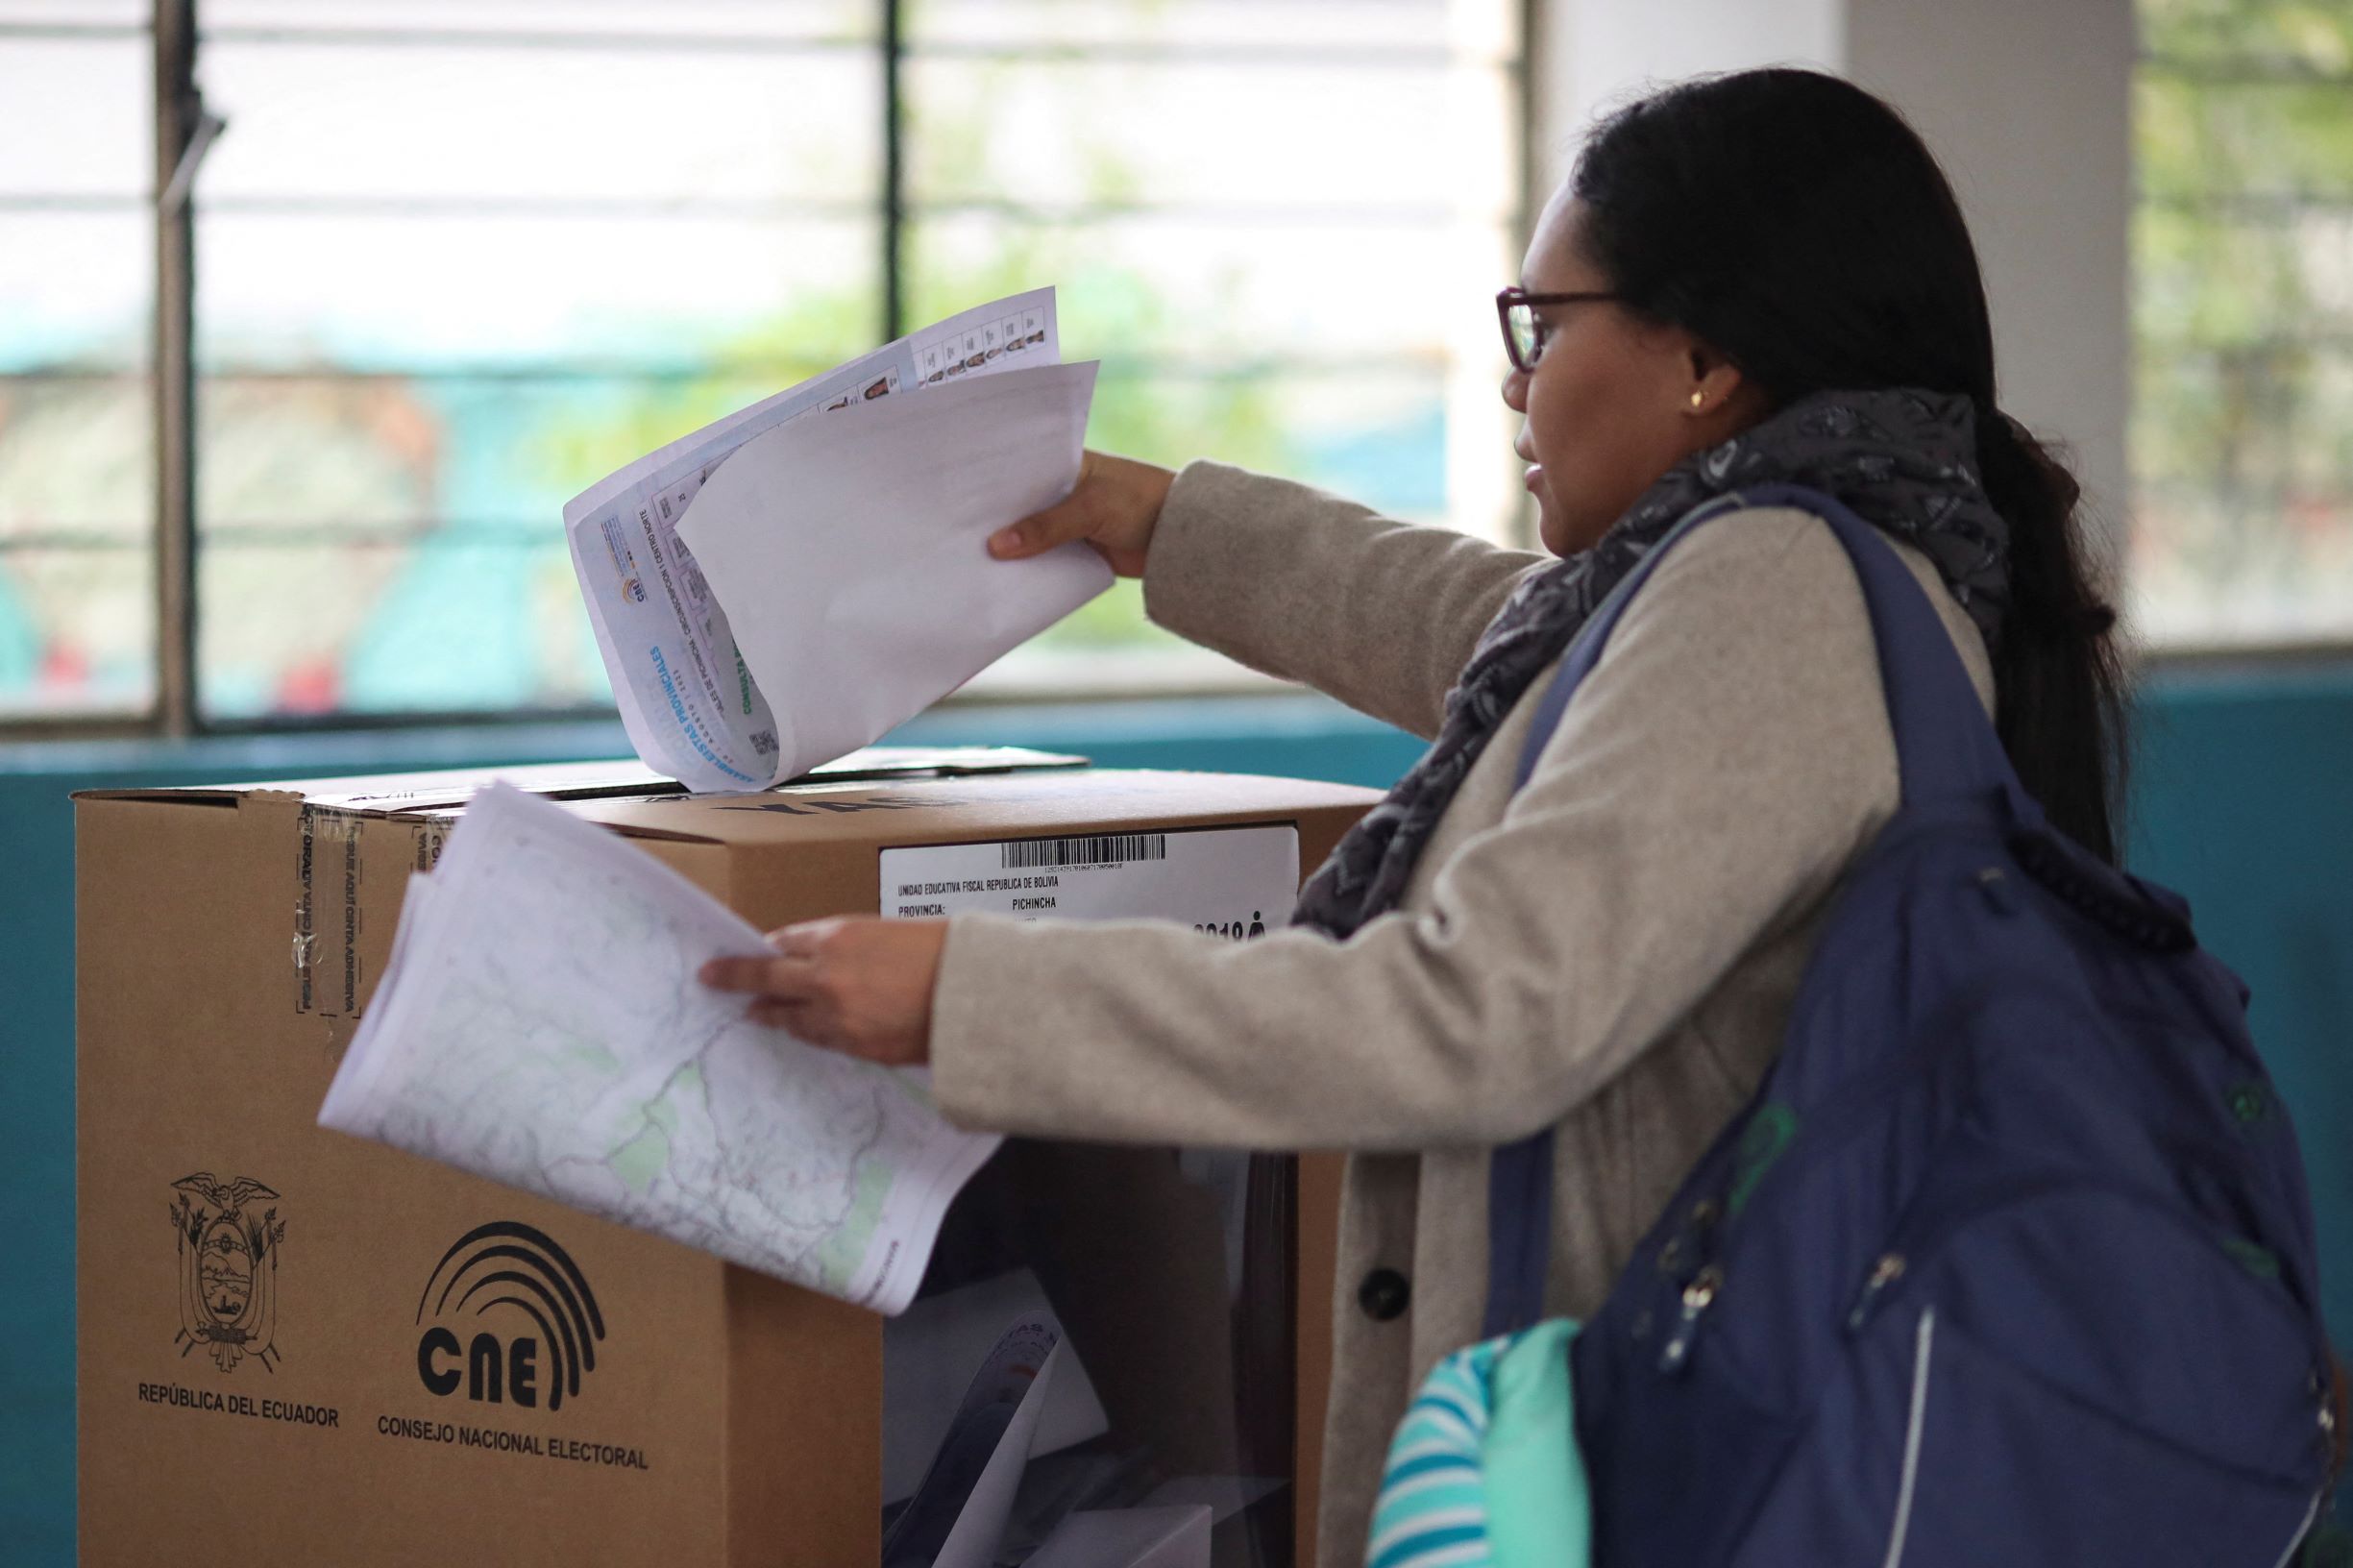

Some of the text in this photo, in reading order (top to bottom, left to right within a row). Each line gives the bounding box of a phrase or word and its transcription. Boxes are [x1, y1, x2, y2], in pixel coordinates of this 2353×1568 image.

[639, 509, 652, 534] NORTE
[648, 533, 663, 564] CENTRO
[689, 640, 708, 678] PICHINCHA
[650, 646, 689, 724] PROVINCIALES
[704, 679, 714, 691] DE
[737, 659, 752, 715] CONSULTA
[897, 875, 1059, 896] UNIDAD EDUCATIVA FISCAL REPUBLICA DE BOLIVIA
[898, 896, 1057, 918] PROVINCIA: PICHINCHA
[417, 1326, 537, 1409] CNE
[138, 1382, 340, 1429] REPÚBLICA DEL ECUADOR
[377, 1414, 650, 1470] CONSEJO NACIONAL ELECTORAL
